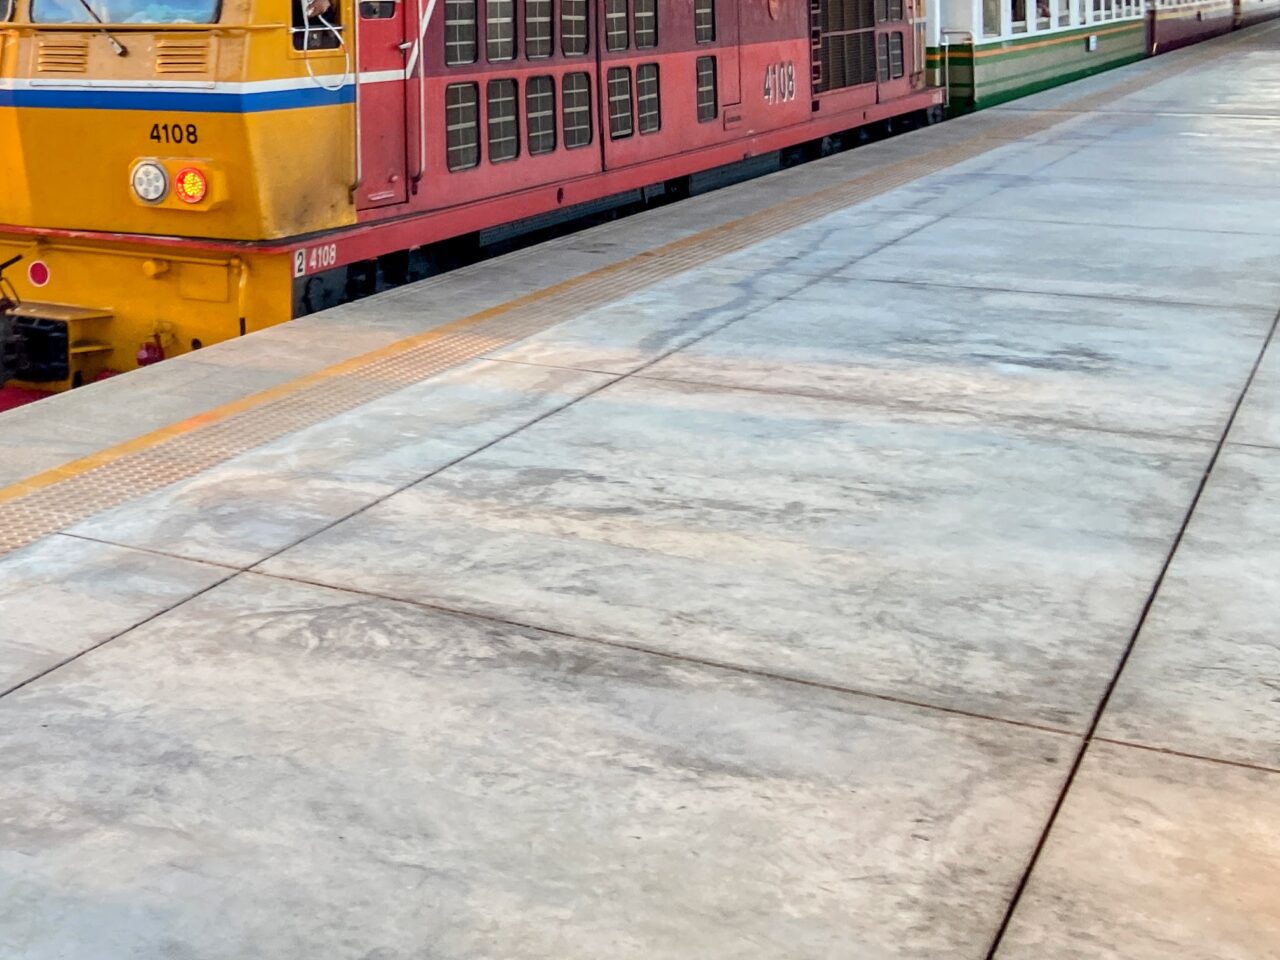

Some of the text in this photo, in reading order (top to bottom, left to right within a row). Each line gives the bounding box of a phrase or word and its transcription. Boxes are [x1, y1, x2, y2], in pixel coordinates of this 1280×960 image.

[763, 61, 795, 105] 4108
[150, 124, 198, 144] 4108
[297, 244, 336, 273] 2 4108
